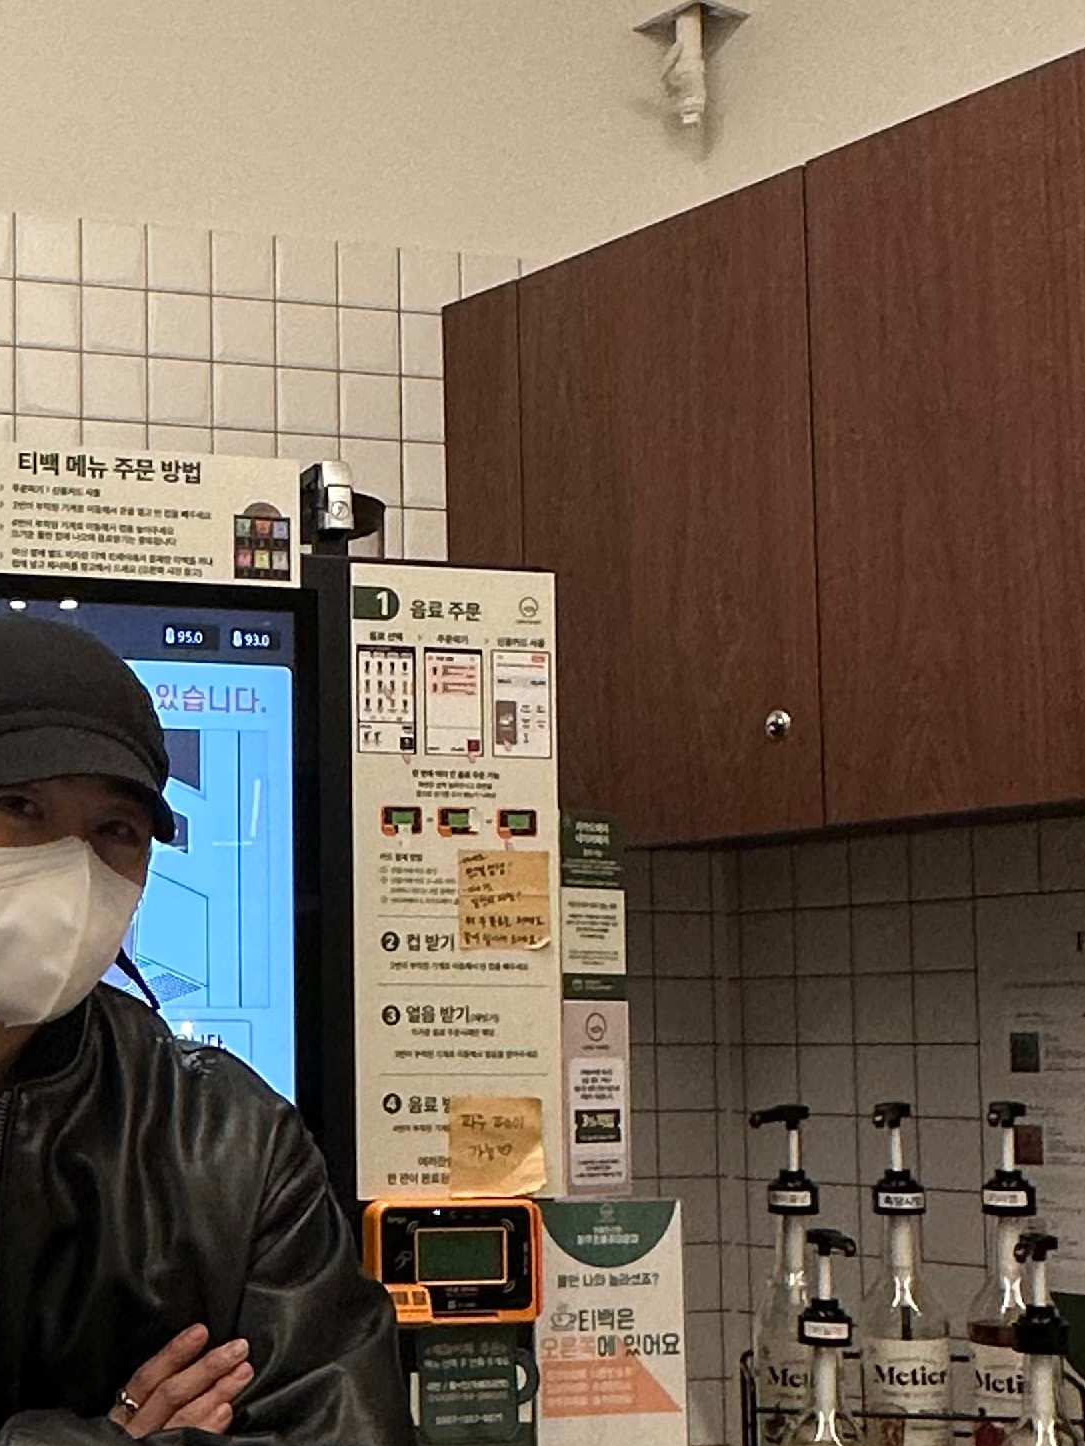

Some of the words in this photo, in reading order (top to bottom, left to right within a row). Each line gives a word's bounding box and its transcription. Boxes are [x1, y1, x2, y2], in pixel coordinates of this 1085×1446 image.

[18, 452, 59, 475] 티백
[65, 453, 108, 478] 메뉴
[114, 458, 155, 482] 주문
[161, 460, 201, 484] 방법
[376, 591, 389, 616] 1
[409, 600, 444, 619] 음료
[448, 602, 481, 622] 주문
[176, 629, 203, 645] 95.0
[243, 632, 271, 647] 93.0
[156, 684, 268, 713] 있습니다.
[381, 931, 401, 952] 2
[407, 934, 420, 951] 컵
[425, 933, 454, 952] 받기
[382, 1093, 402, 1114] 4
[408, 1096, 438, 1114] 음료
[578, 1307, 635, 1332] 티백은
[623, 1333, 681, 1357] 있어요
[875, 1364, 947, 1386] Metier
